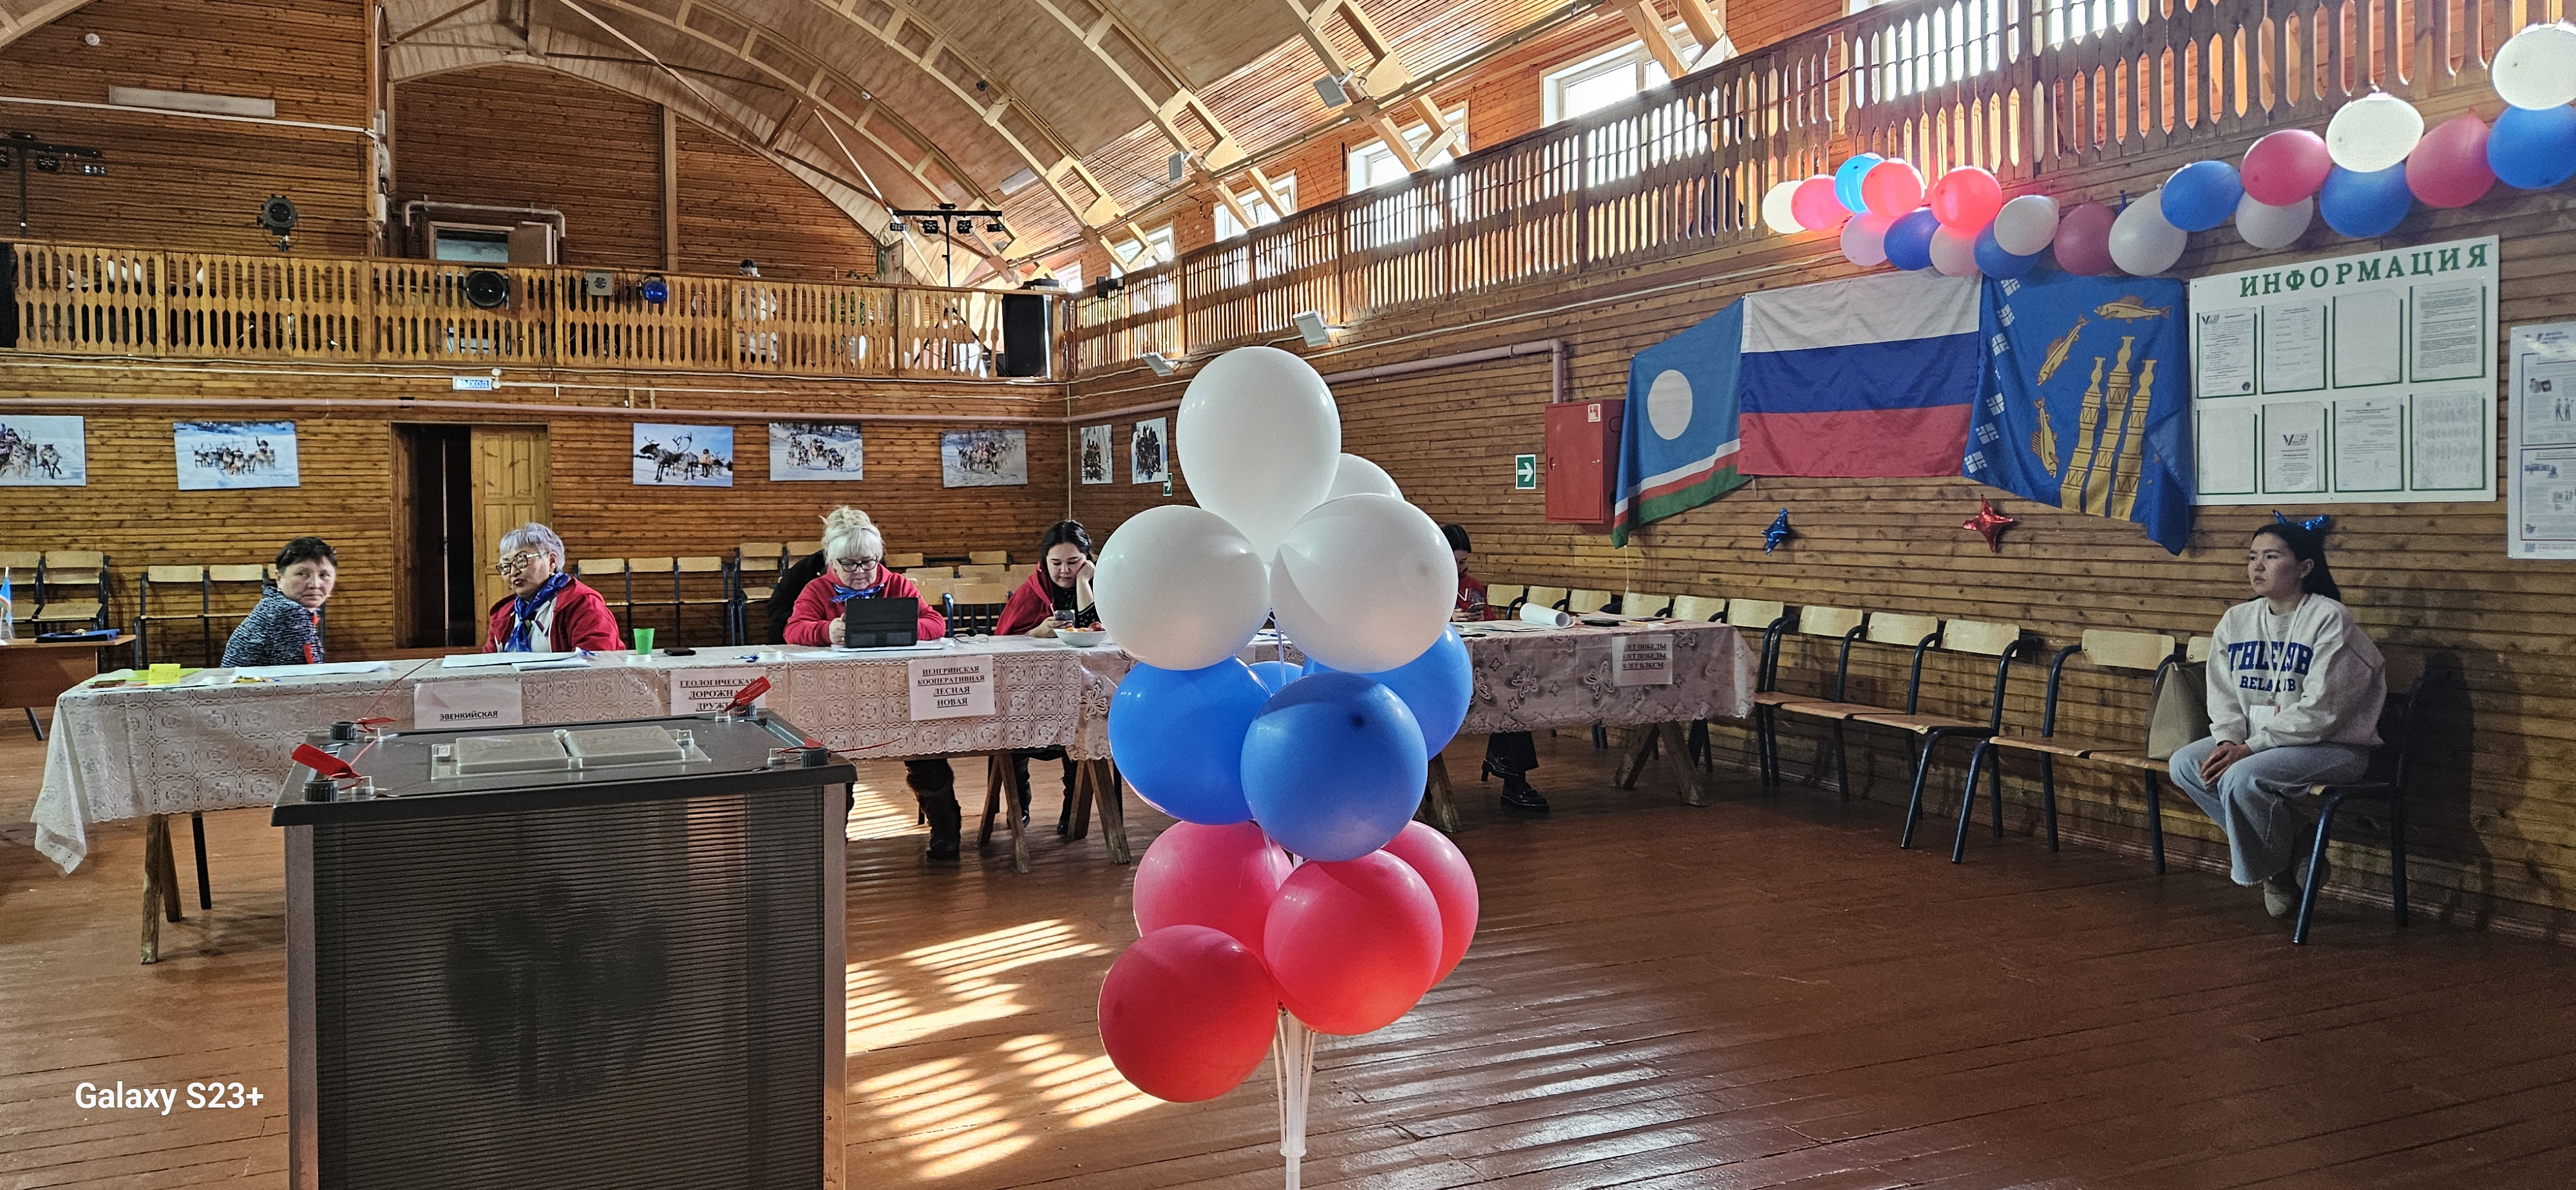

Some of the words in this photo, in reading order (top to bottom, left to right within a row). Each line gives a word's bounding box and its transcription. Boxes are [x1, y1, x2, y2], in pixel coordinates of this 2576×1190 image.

[2239, 243, 2488, 298] ИНФОРМАЦИЯ
[922, 666, 980, 675] ИЕНГРИНСКАЯ
[918, 675, 985, 685] КООПЕРАТИВНАЯ
[933, 686, 970, 695] ЛЕСНАЯ
[937, 697, 968, 706] НОВАЯ
[440, 710, 498, 721] ЭВЕНКИЙСКАЯ
